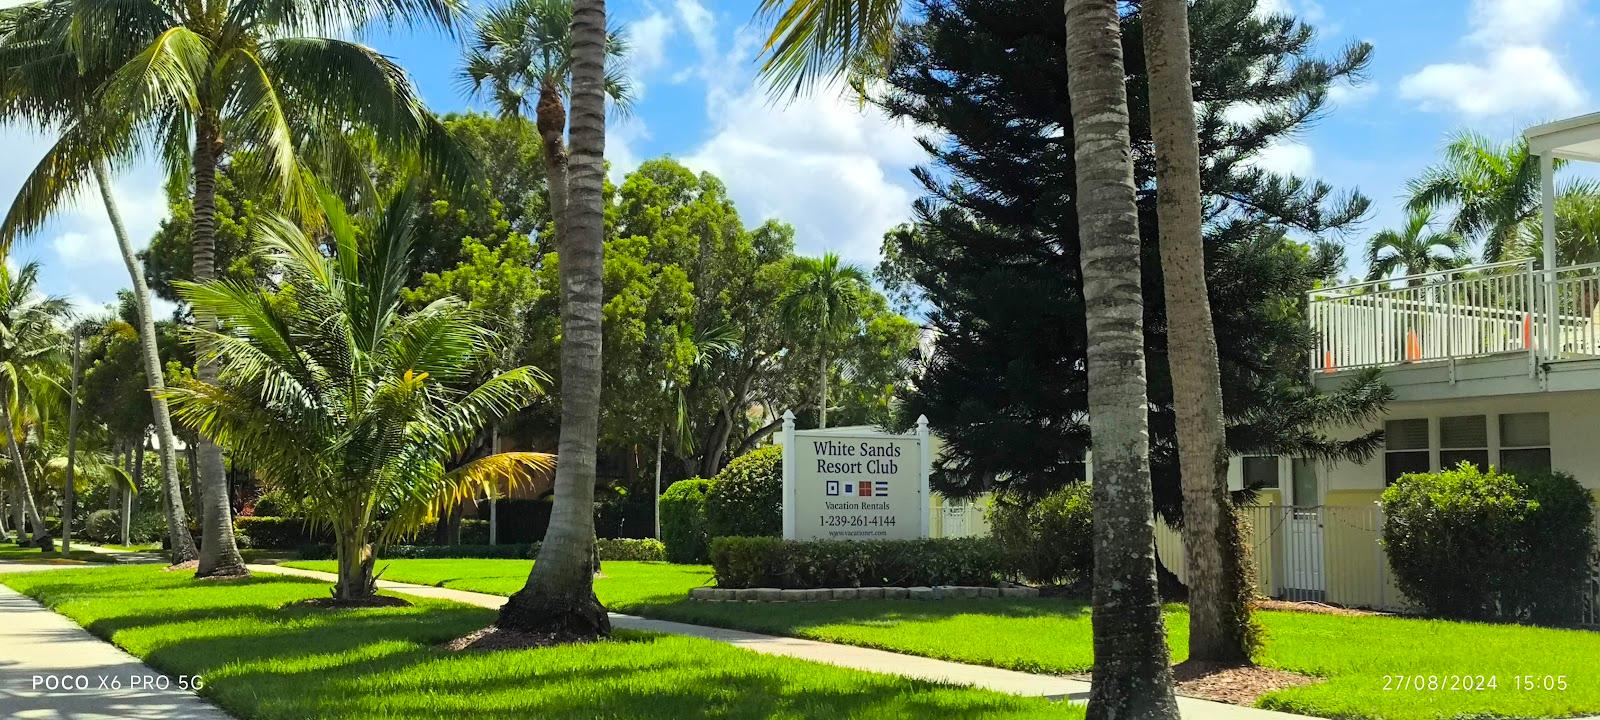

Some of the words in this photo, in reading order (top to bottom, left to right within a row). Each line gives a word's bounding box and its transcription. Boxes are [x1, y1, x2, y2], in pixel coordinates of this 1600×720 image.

[813, 440, 855, 456] White
[860, 442, 901, 457] Sands
[817, 459, 862, 474] Resort
[866, 459, 898, 474] Club
[825, 501, 859, 510] Vacation
[861, 501, 890, 510] Rentals
[820, 515, 896, 527] 1-239-261-4144
